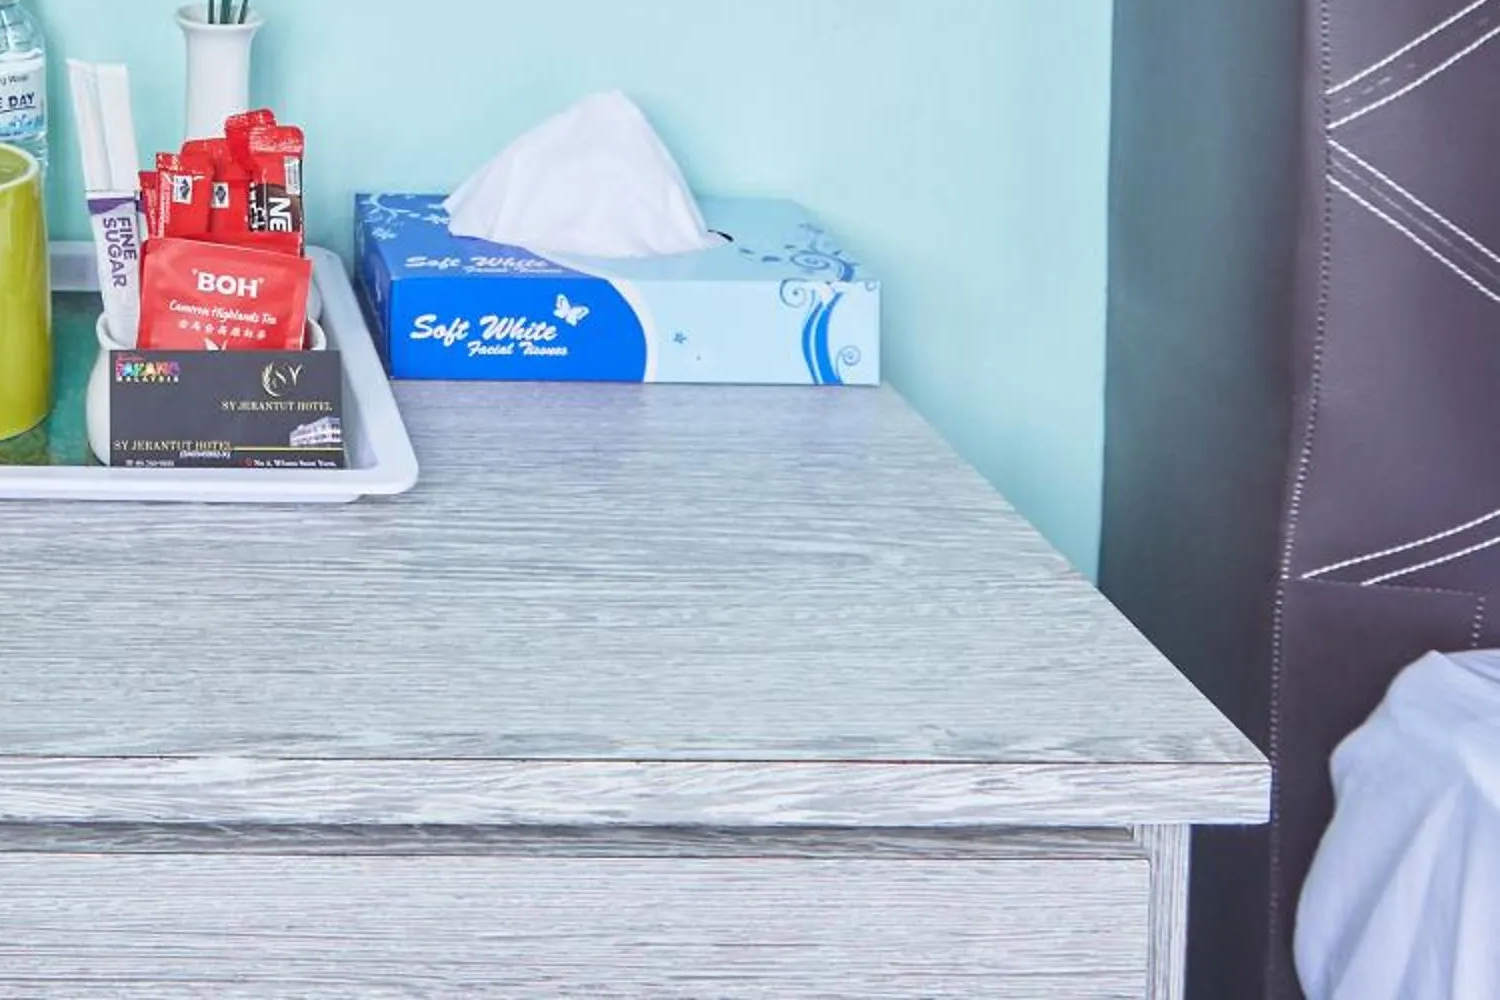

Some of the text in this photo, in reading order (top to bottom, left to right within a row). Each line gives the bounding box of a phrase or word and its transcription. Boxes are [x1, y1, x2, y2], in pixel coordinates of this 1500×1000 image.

[8, 91, 36, 109] DAY
[117, 216, 138, 261] FINE
[103, 217, 128, 288] SUGAR
[404, 256, 461, 269] Soft
[410, 313, 558, 347] Soft White
[467, 340, 515, 357] Facial
